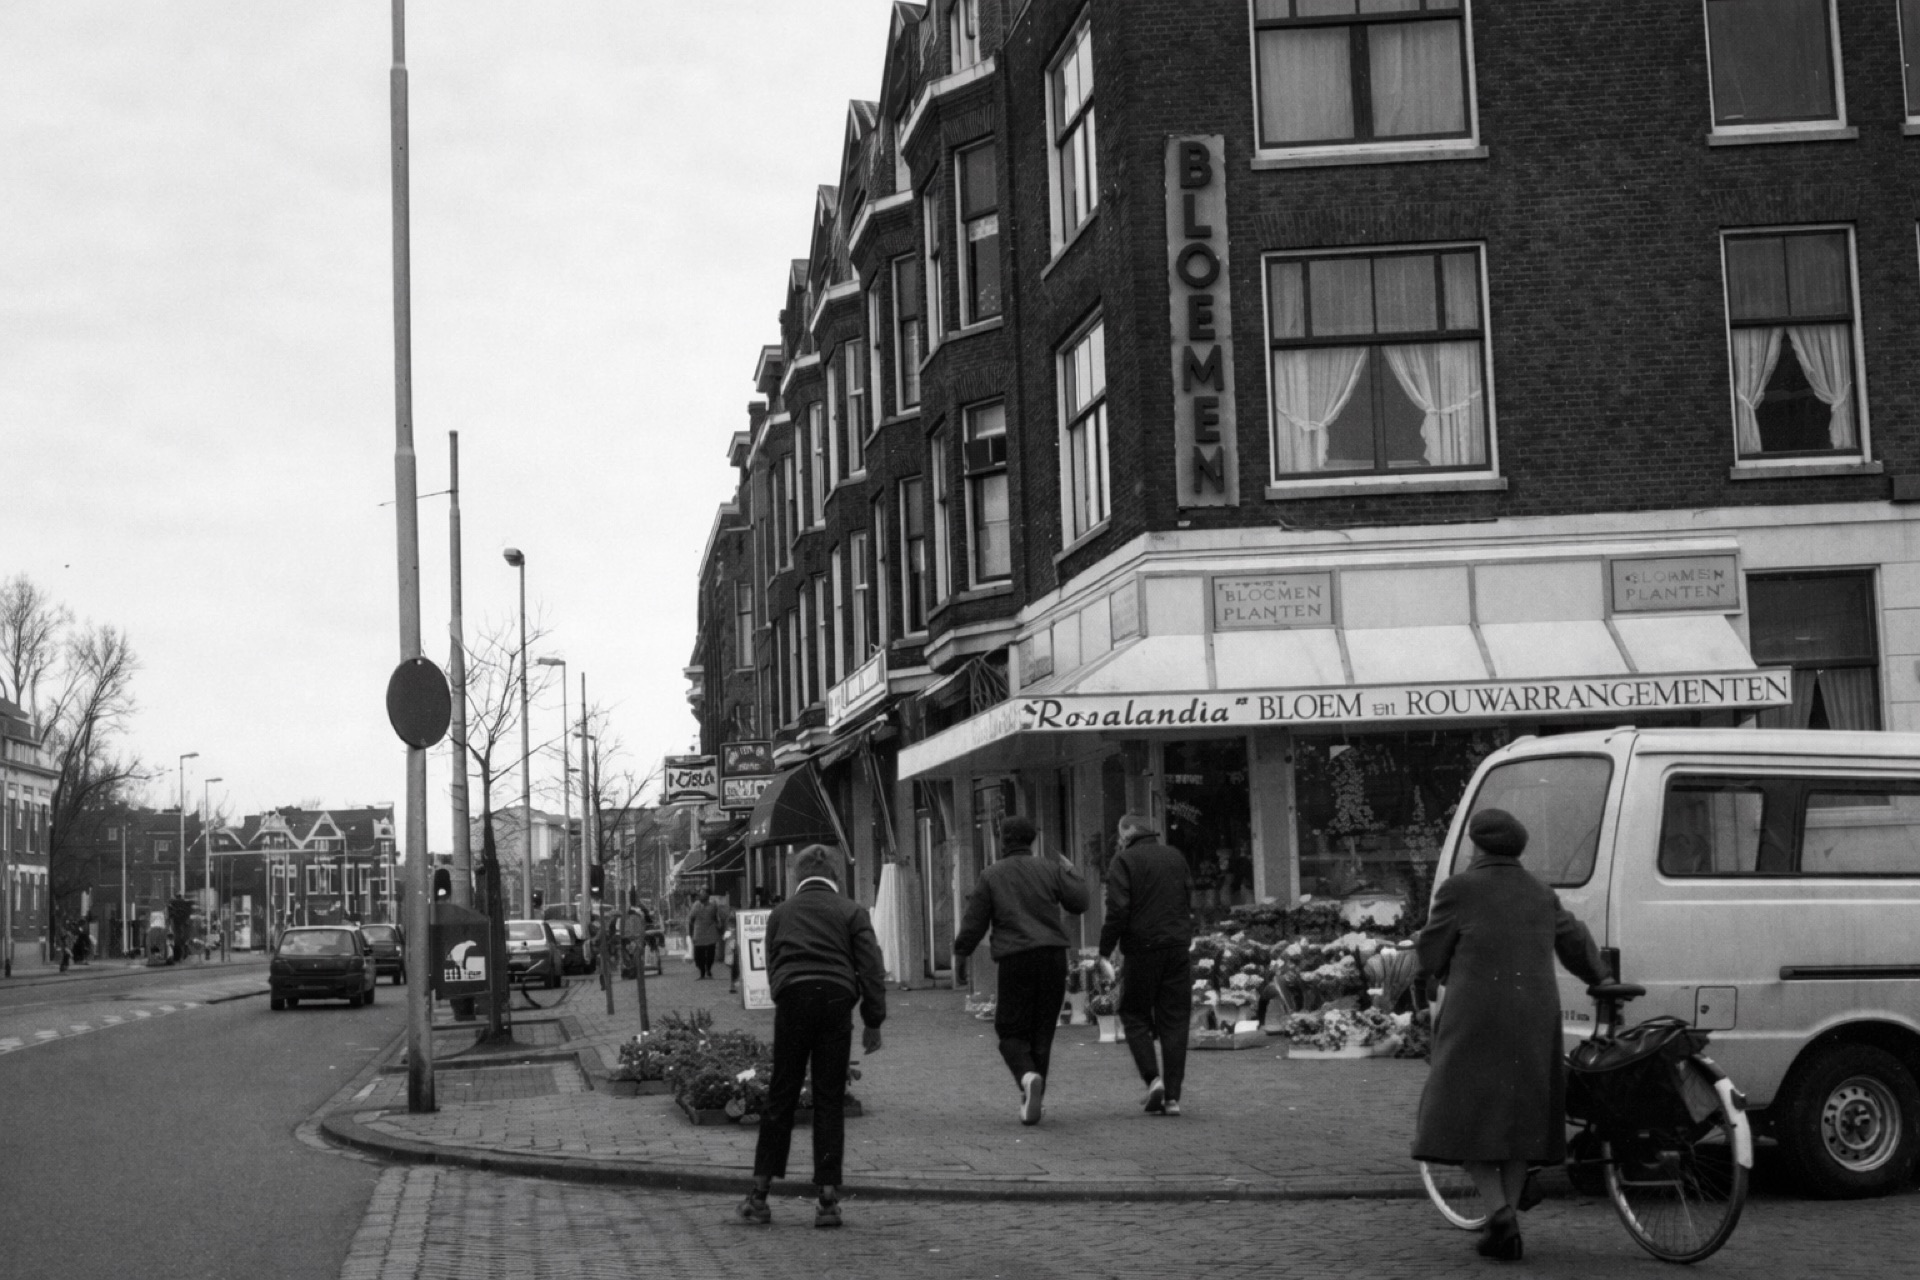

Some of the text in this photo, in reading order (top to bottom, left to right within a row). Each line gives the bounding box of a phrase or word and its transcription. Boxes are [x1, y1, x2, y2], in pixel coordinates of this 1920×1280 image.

[1176, 141, 1225, 494] BLOEMEN
[1626, 584, 1722, 601] PLANTEN
[1224, 603, 1322, 621] PLANTEN
[1258, 692, 1364, 720] BLOEM
[1405, 675, 1788, 716] ROUWARRANGEMENTEN
